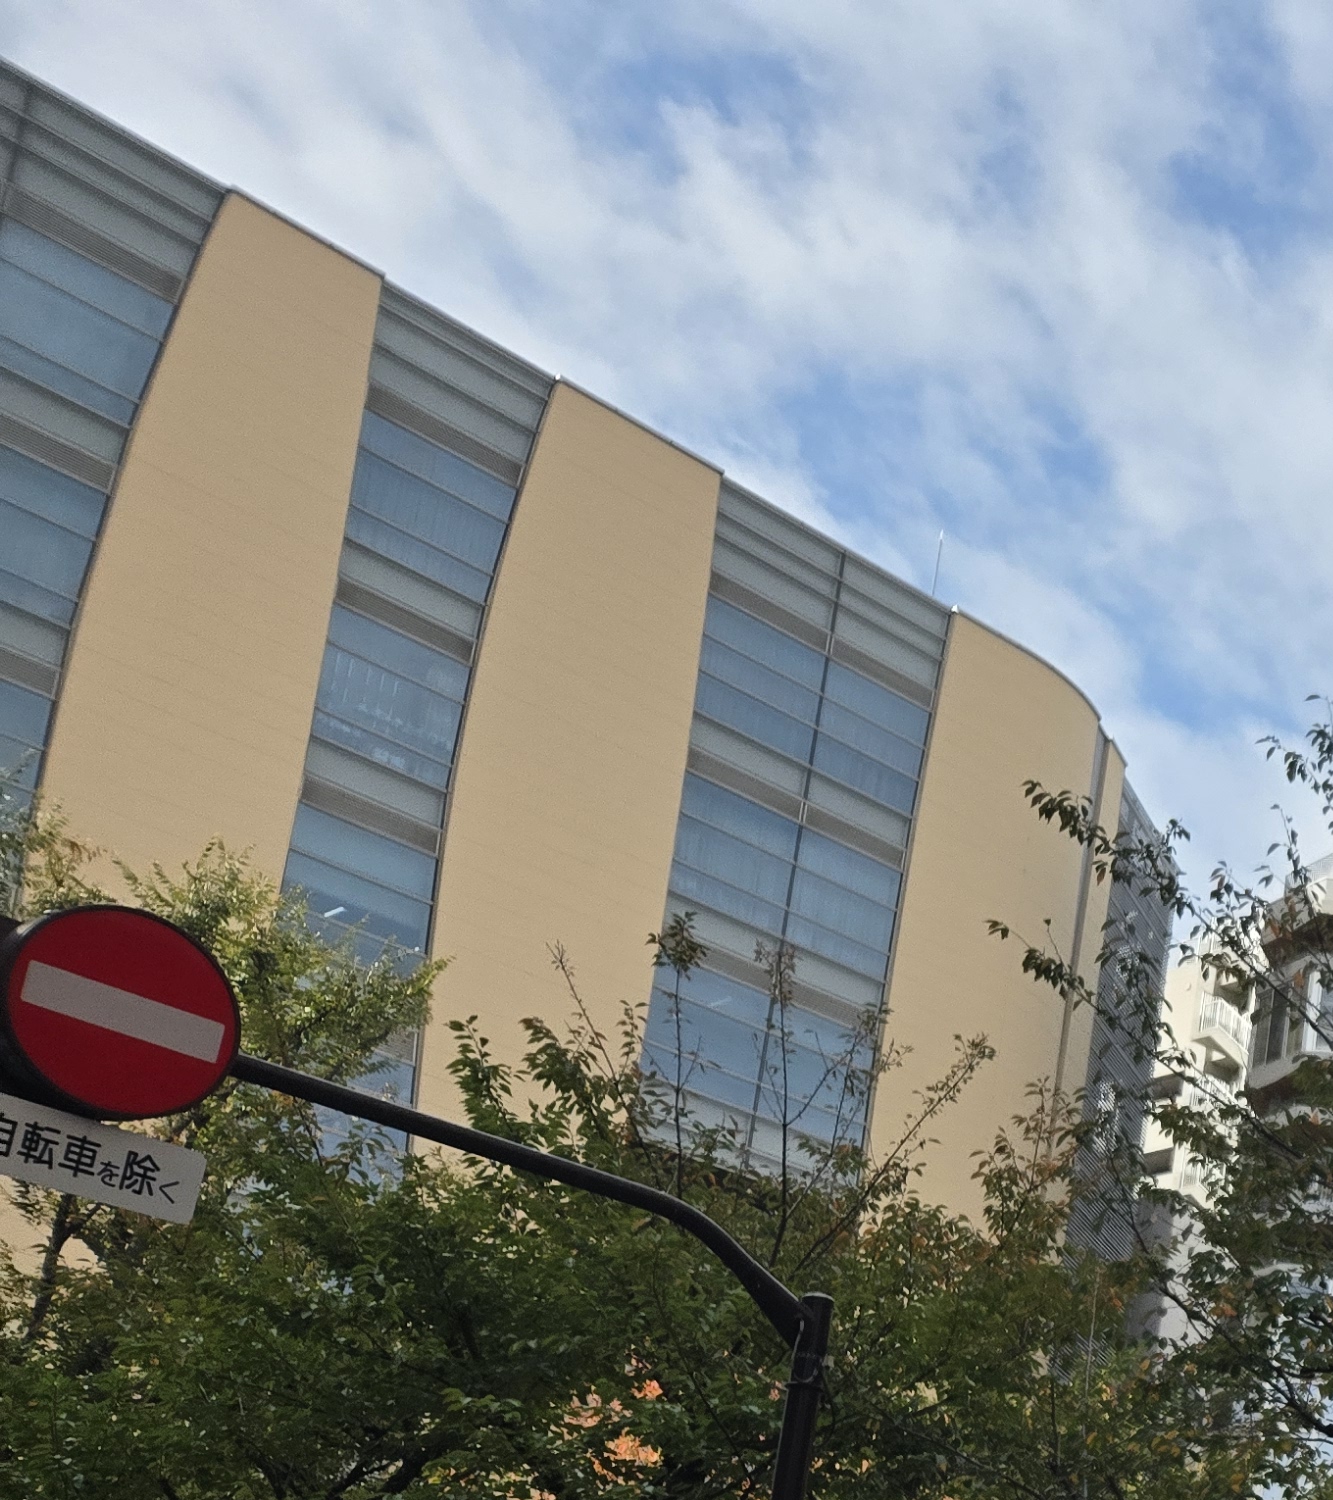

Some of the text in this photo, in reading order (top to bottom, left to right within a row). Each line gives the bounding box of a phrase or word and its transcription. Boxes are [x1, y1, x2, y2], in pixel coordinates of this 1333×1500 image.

[0, 1112, 180, 1204] 自転車を除く
